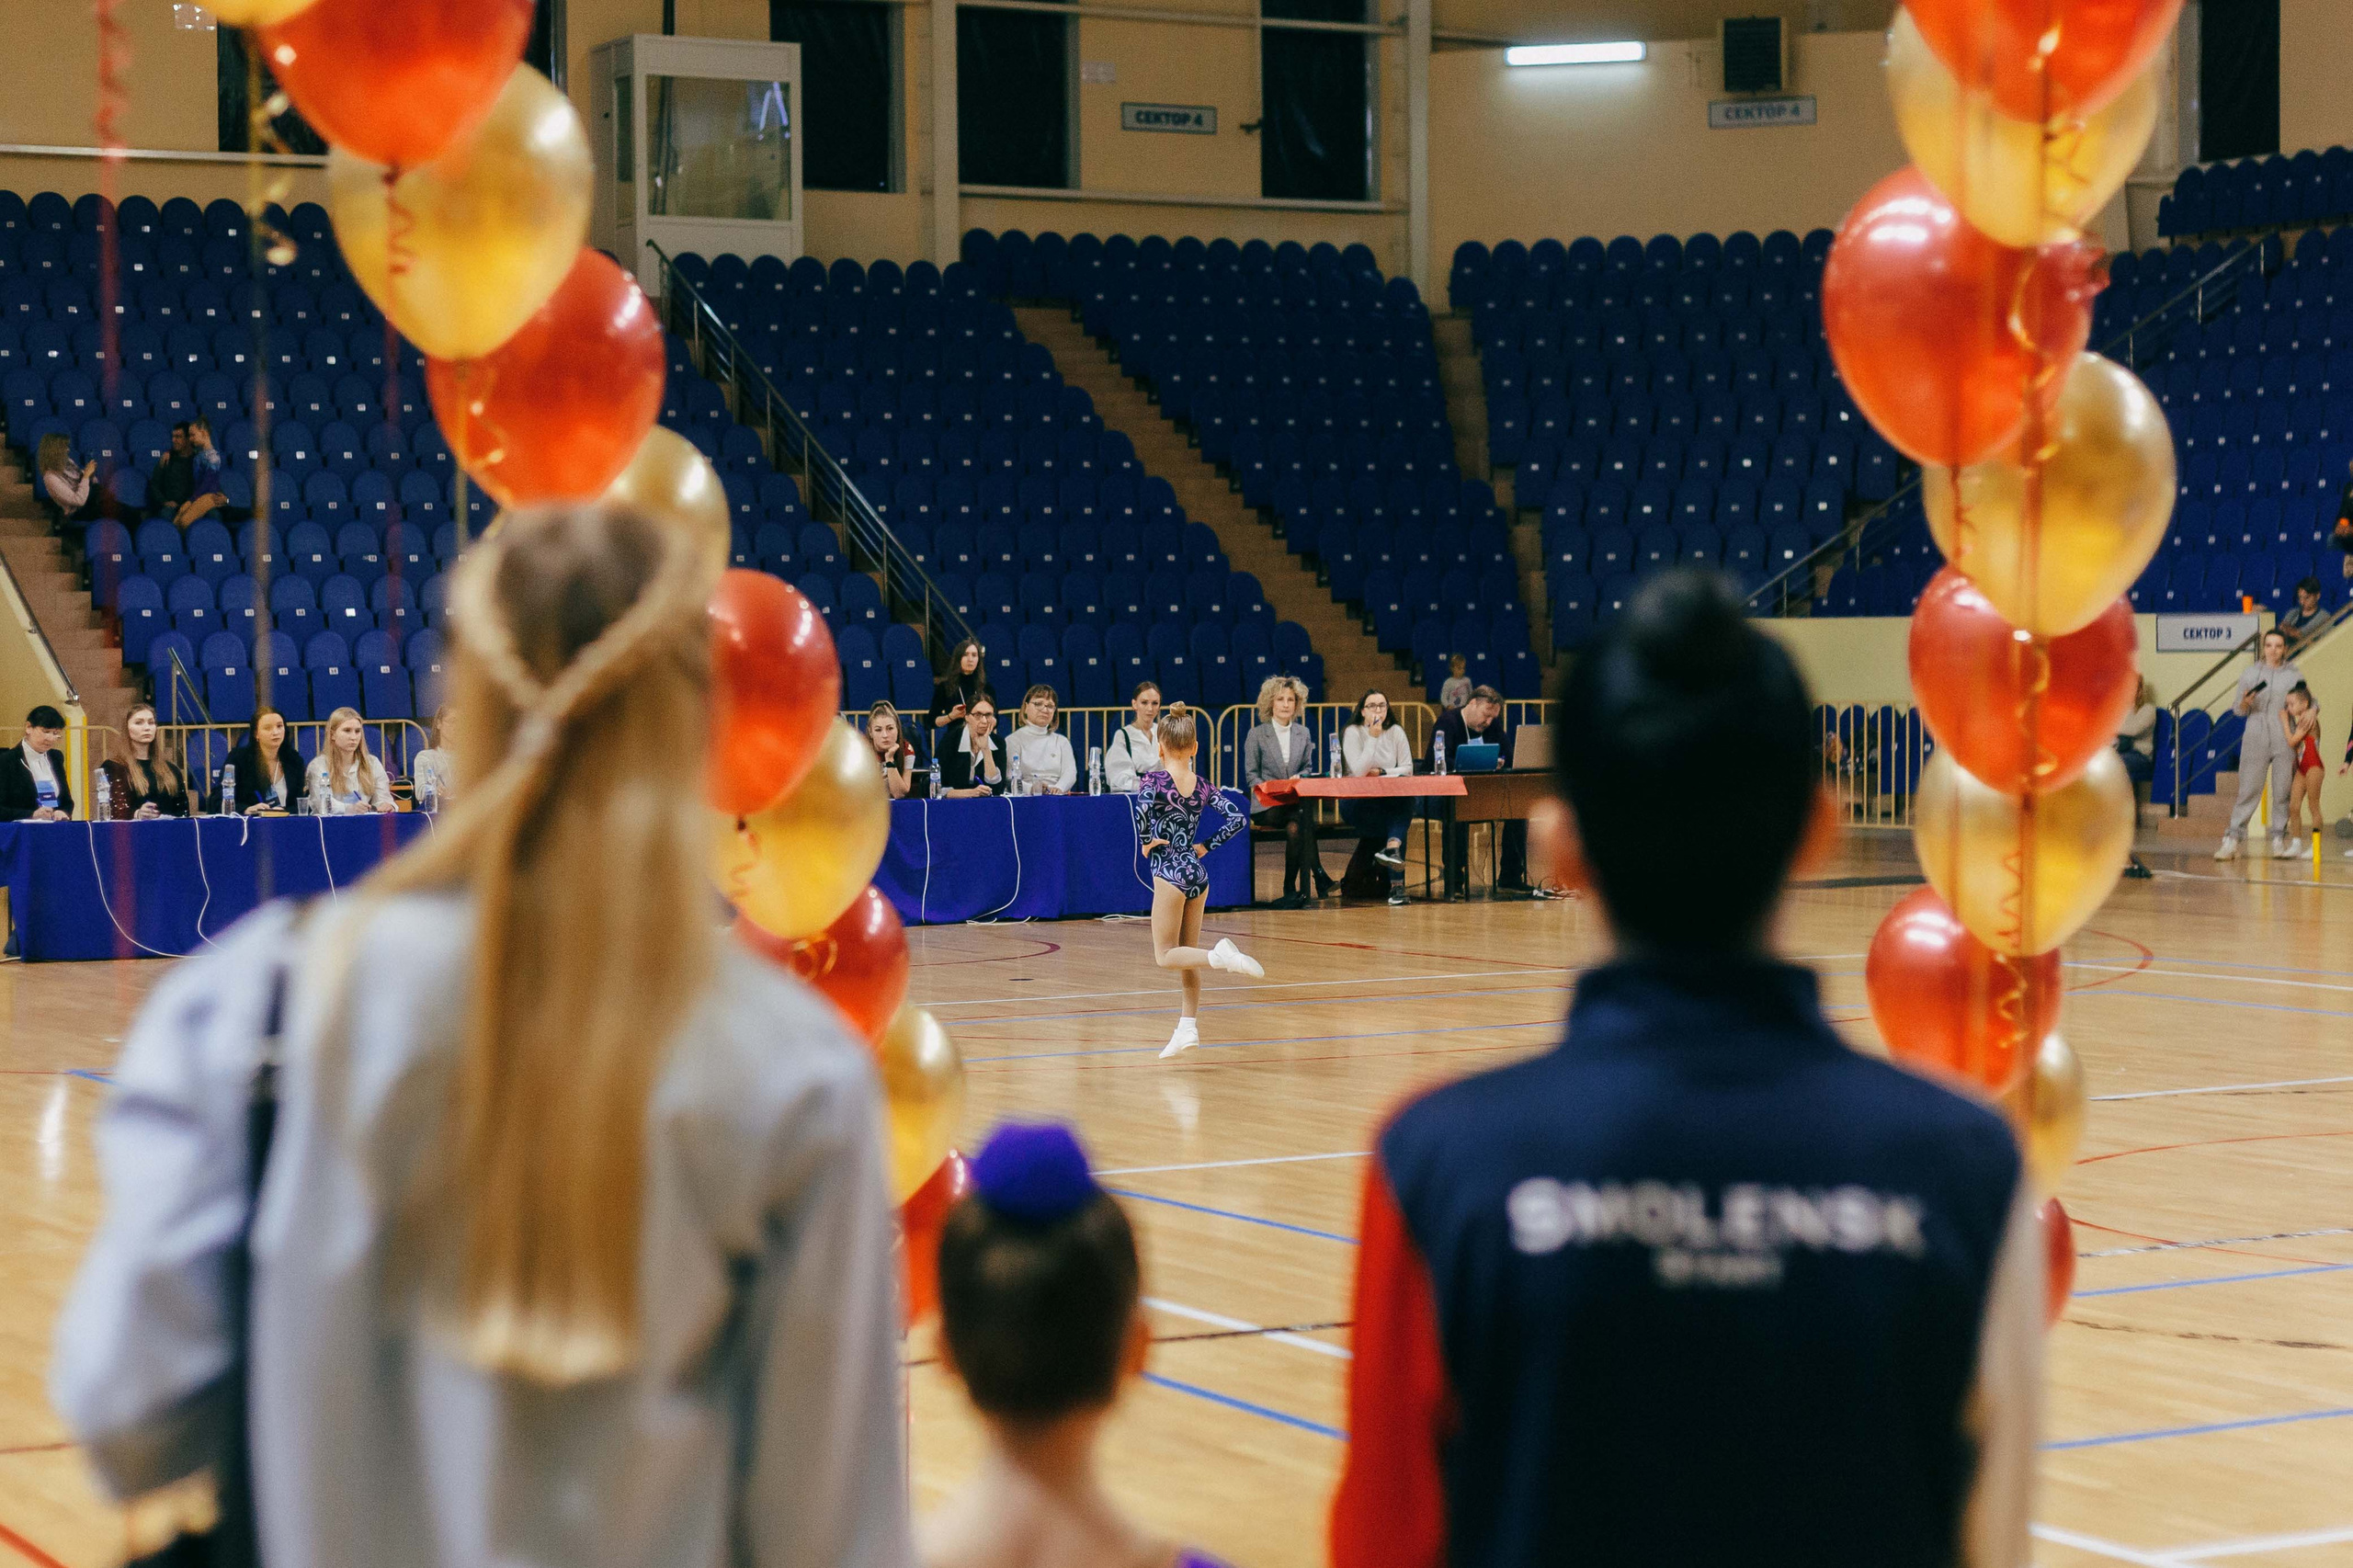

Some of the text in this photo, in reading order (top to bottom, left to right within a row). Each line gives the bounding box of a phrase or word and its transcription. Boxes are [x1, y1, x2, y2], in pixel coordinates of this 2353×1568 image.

[1135, 110, 1191, 125] СЕКТОР
[1724, 105, 1787, 119] СЕКТОР
[2183, 627, 2232, 639] СЕКТОР 3
[1508, 1178, 1926, 1258] SMOLENSK
